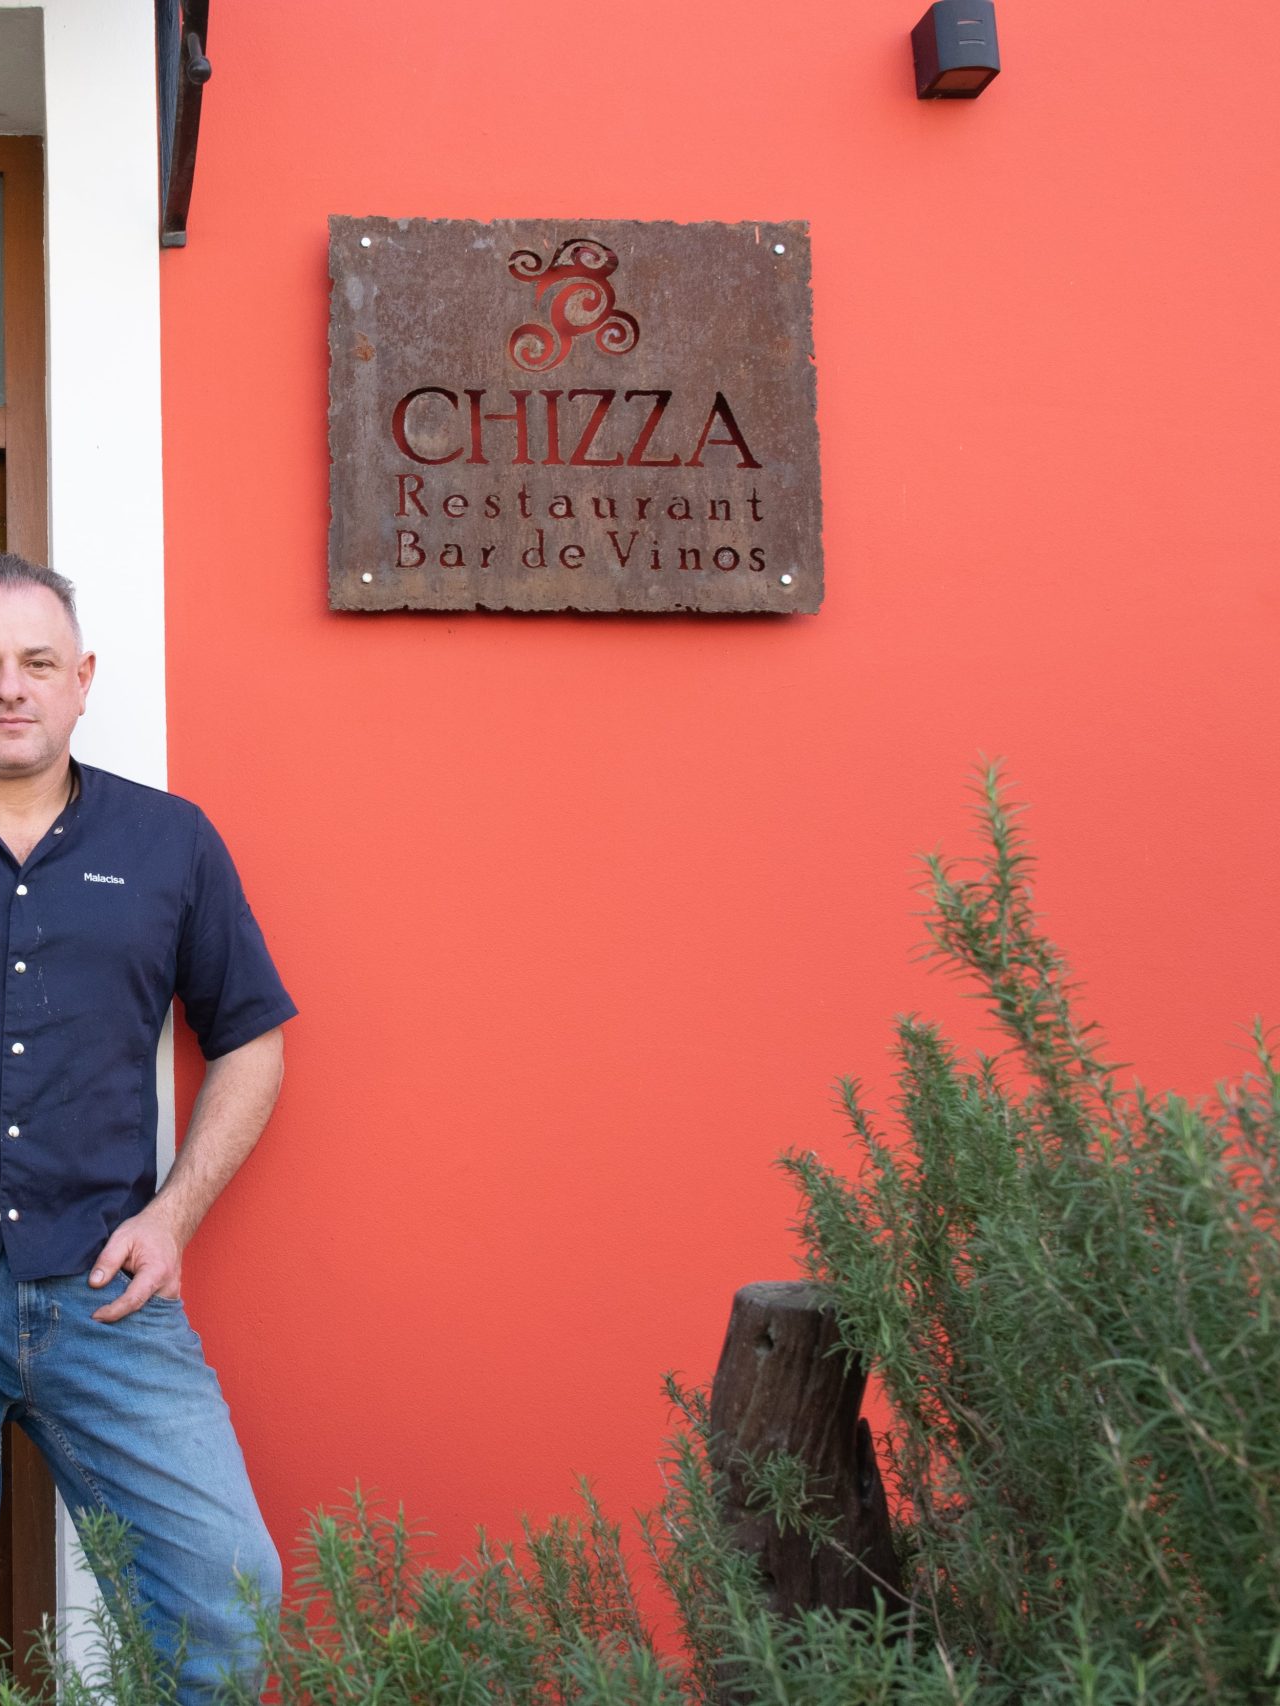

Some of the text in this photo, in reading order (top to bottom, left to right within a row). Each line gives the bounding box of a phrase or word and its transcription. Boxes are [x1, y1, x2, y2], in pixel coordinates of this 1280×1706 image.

[392, 386, 763, 469] CHIZZA
[395, 473, 763, 522] Restaurant
[395, 528, 766, 572] Bar de Vinos
[84, 872, 125, 884] Malacisa
